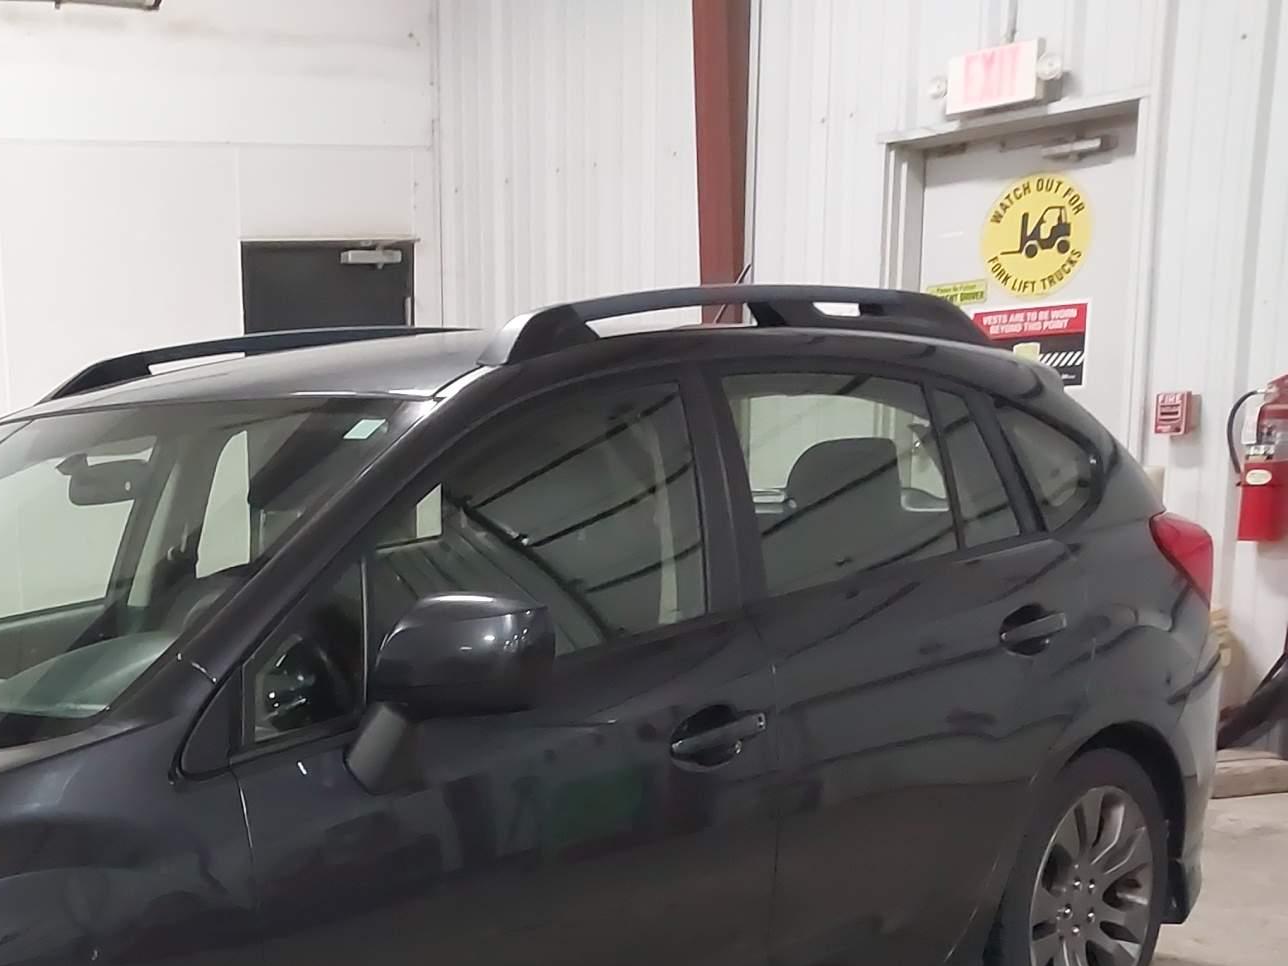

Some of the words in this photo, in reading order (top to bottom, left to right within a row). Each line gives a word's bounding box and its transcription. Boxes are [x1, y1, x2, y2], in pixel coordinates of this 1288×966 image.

[990, 181, 1031, 224] WATCH
[1036, 177, 1063, 194] OUT
[1062, 187, 1085, 215] FOR
[987, 255, 1012, 286] FORK
[1011, 277, 1036, 293] LIFT
[1040, 249, 1082, 290] TRUCKS
[984, 314, 1007, 325] VESTS
[1008, 312, 1025, 322] ARE
[1026, 311, 1038, 321] TO
[1039, 310, 1049, 320] BE
[990, 324, 1022, 335] BEYOND
[1023, 321, 1042, 332] THIS
[1043, 319, 1069, 330] POINT
